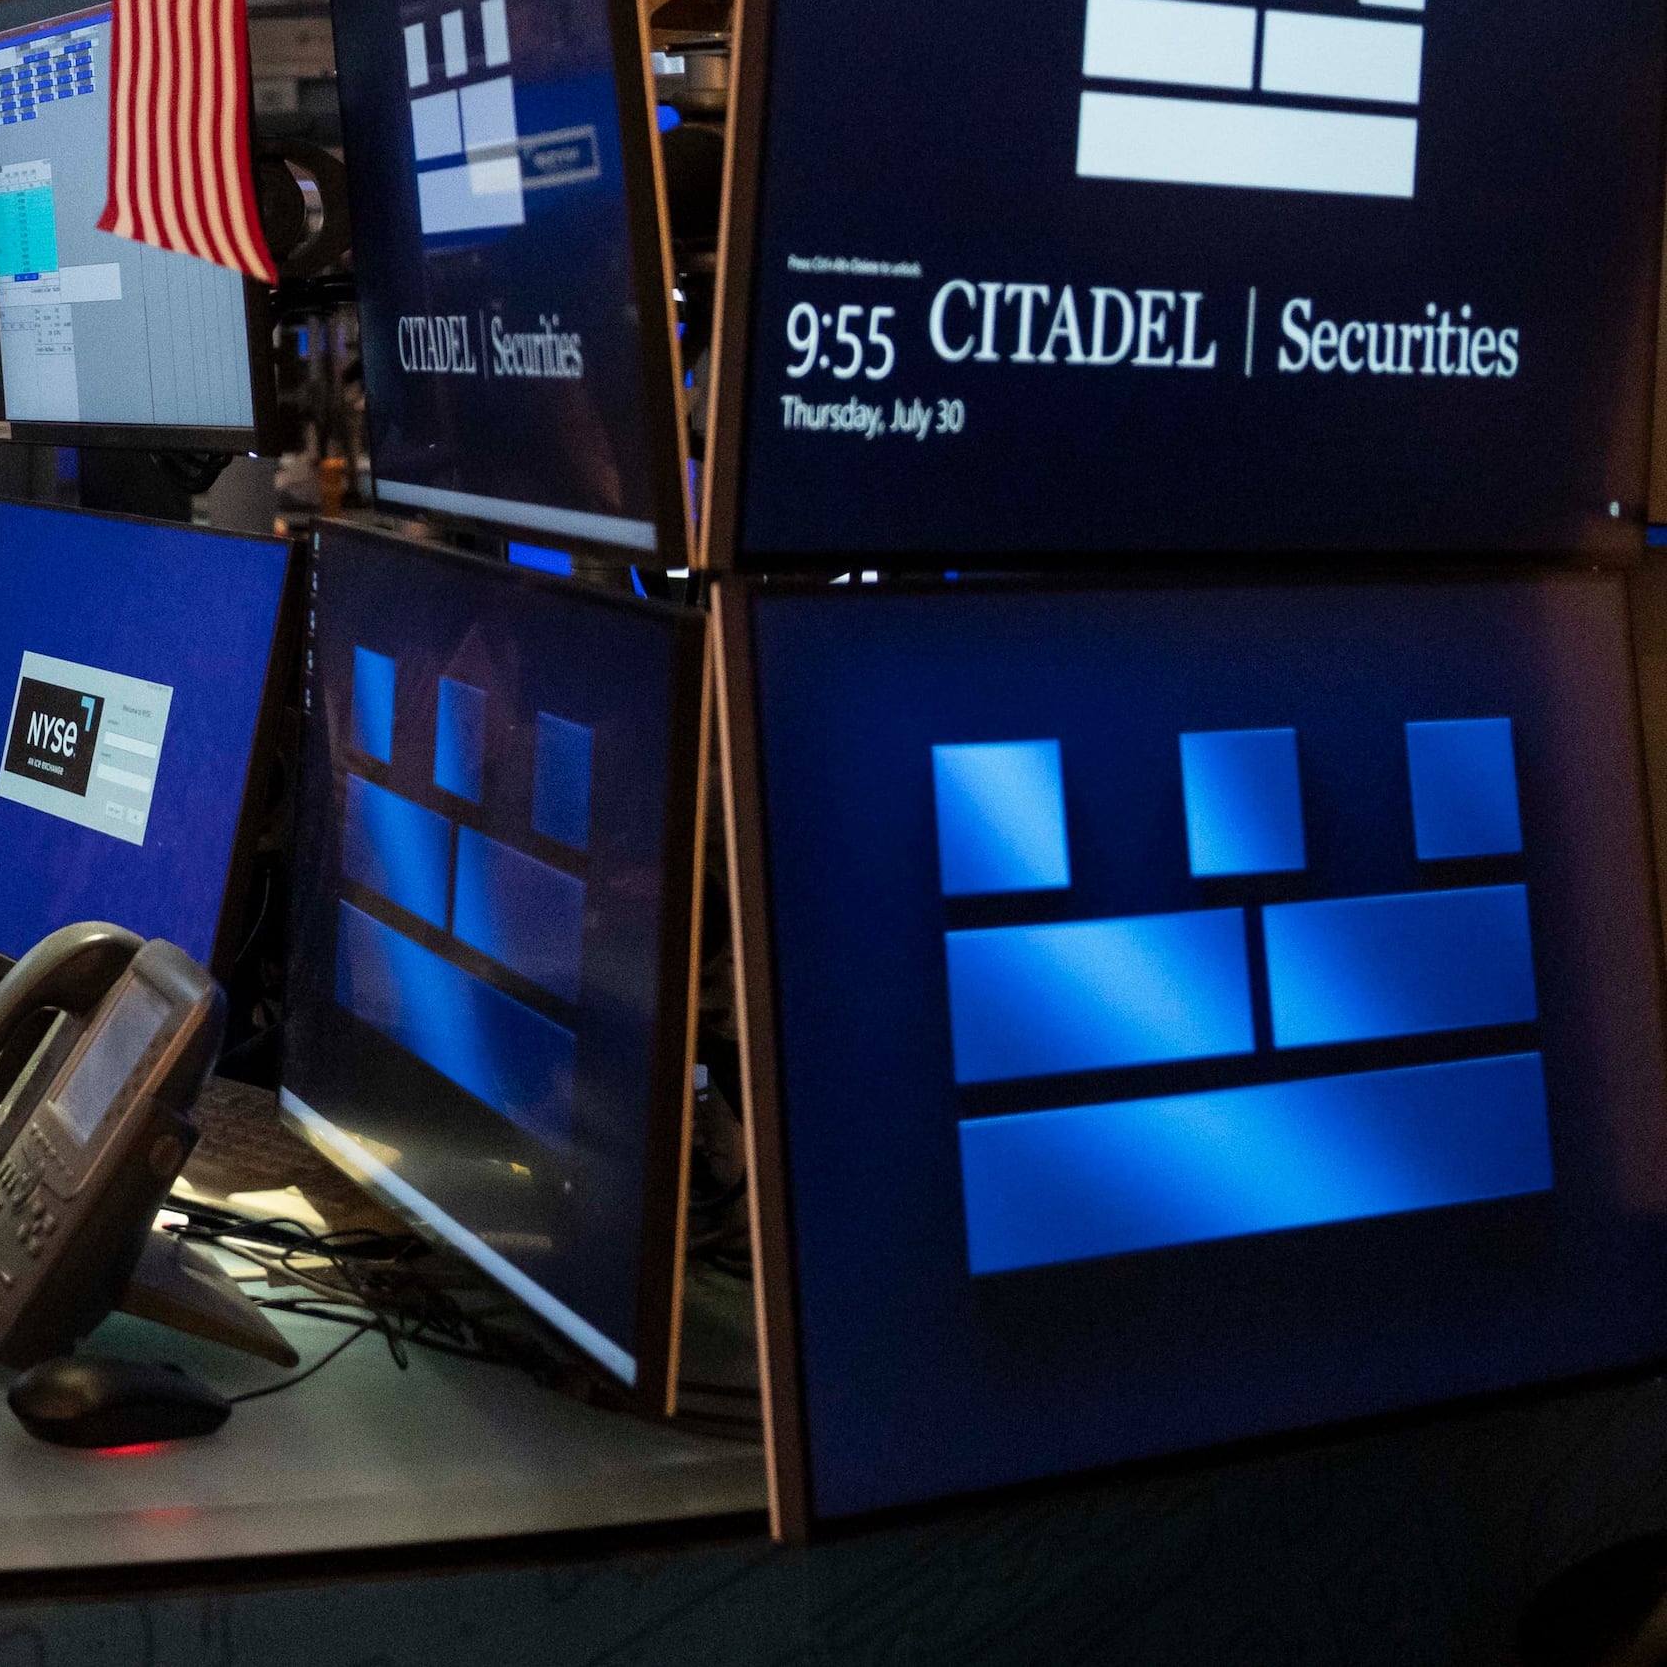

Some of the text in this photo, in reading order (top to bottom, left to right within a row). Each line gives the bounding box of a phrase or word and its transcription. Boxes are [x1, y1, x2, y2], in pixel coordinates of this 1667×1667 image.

[399, 315, 582, 377] CITADEL Securities
[787, 302, 894, 379] 9:55
[930, 280, 1518, 376] CITADEL Securities
[781, 395, 964, 439] Thursday, July 30
